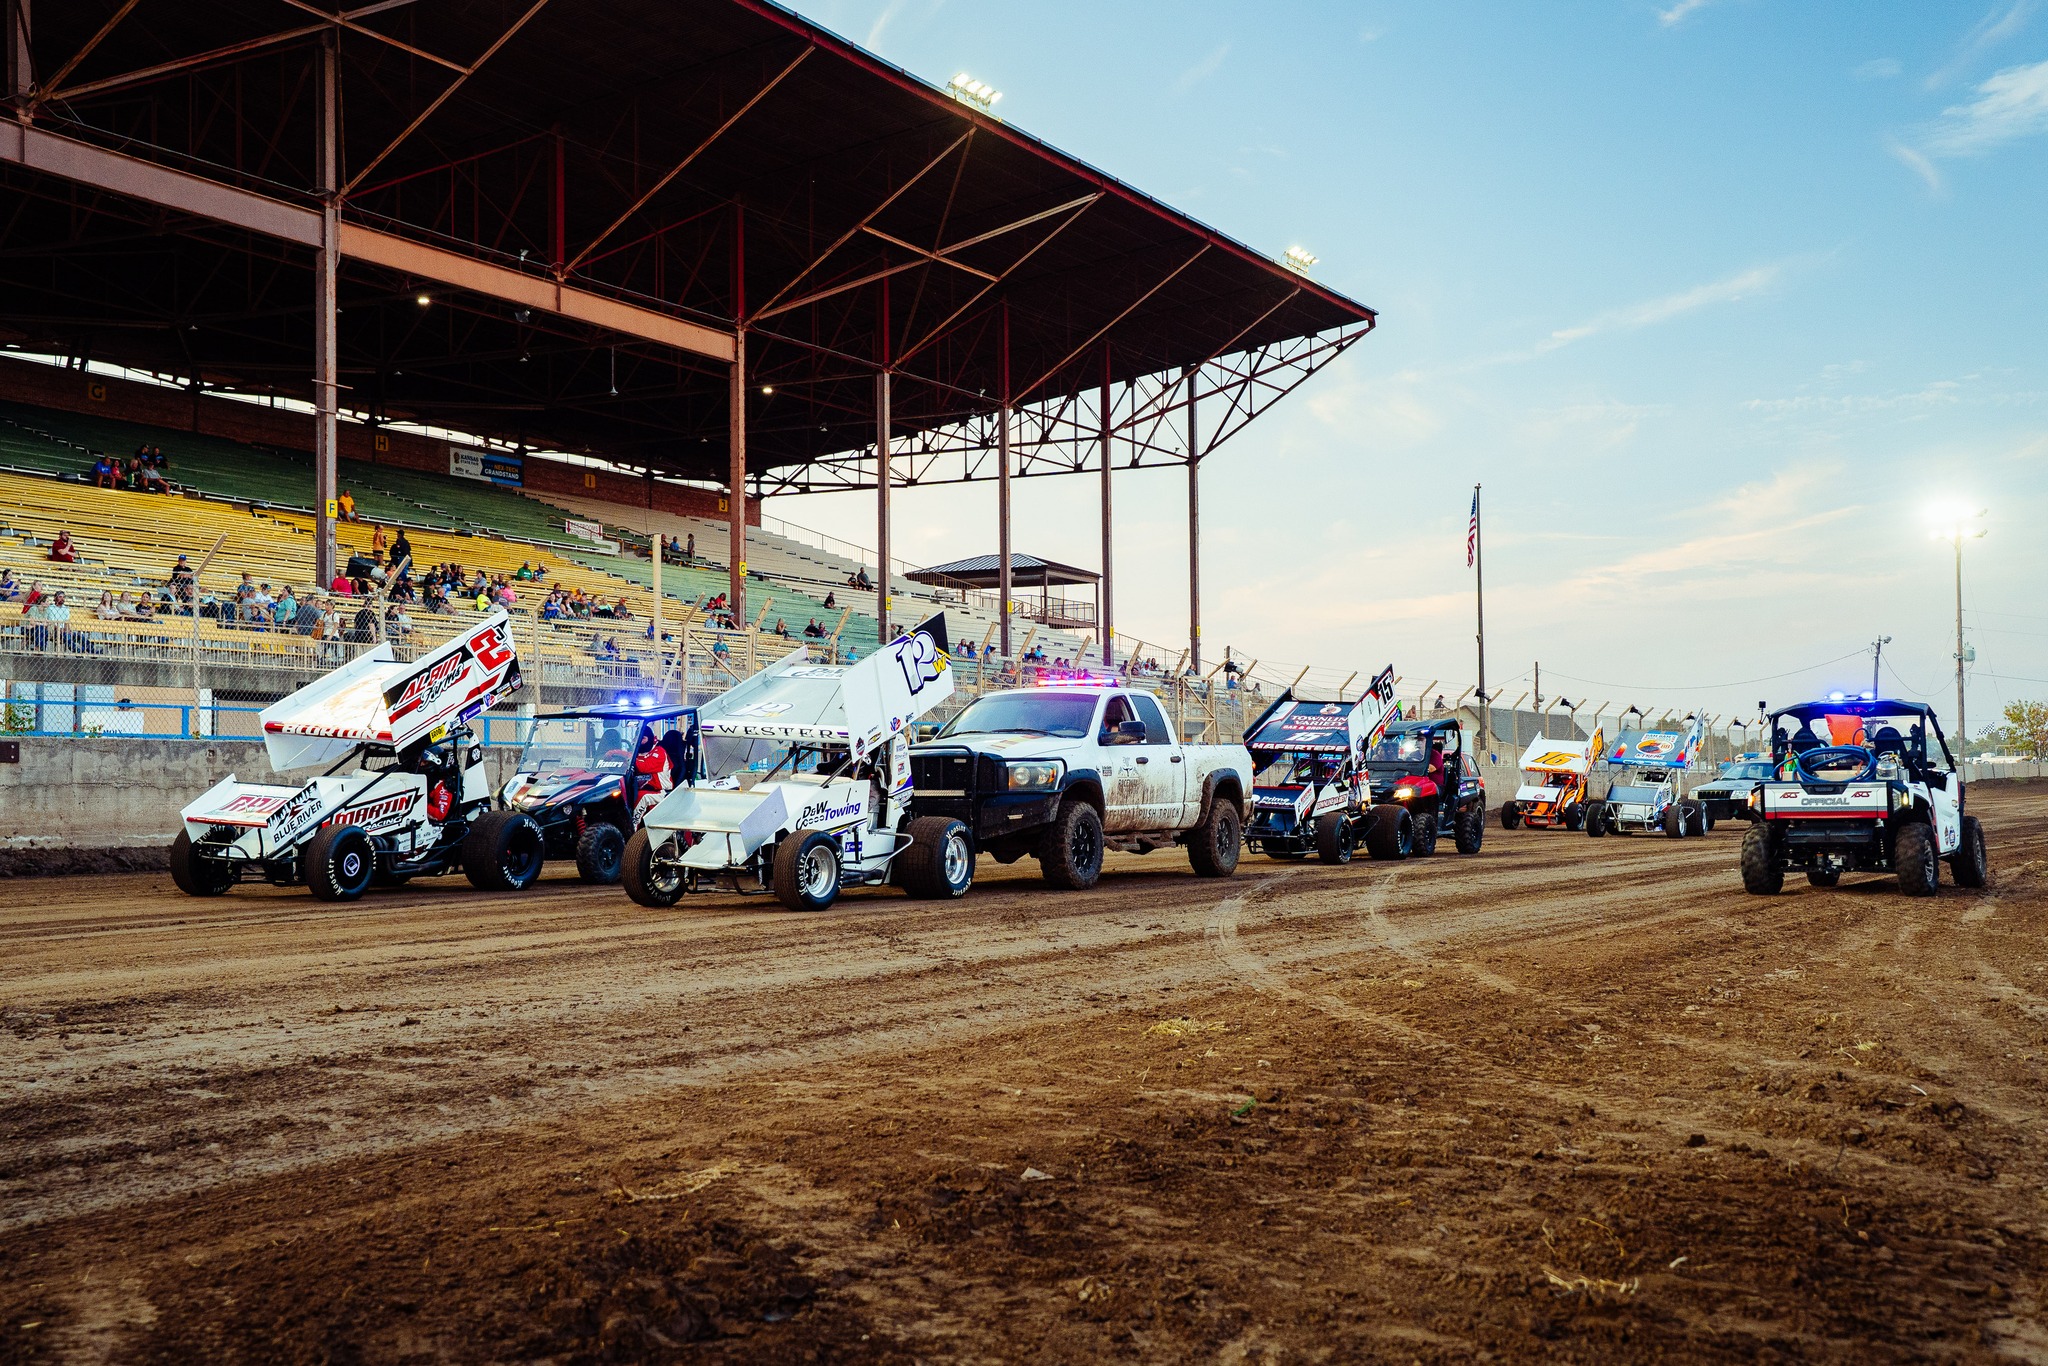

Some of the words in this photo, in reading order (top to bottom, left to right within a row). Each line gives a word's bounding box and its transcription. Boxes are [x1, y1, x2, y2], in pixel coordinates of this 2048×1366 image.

[91, 385, 102, 398] G
[377, 436, 387, 451] H
[484, 468, 519, 480] GRANDSTAND
[329, 502, 336, 514] F
[398, 653, 462, 703] ALBIN
[418, 663, 464, 711] Farms
[718, 724, 837, 739] WESTER
[1252, 742, 1348, 752] HAFERTEPE
[1531, 751, 1582, 766] 16
[1801, 797, 1850, 806] OFFICIAL
[334, 794, 412, 825] MARTIN
[802, 800, 828, 819] D&W
[825, 802, 861, 821] Towing
[1139, 808, 1156, 819] PUSH
[1159, 808, 1180, 819] TRUCK
[273, 820, 297, 843] BLUE
[297, 800, 322, 825] RIVER
[363, 814, 403, 831] RACING
[523, 818, 544, 842] Hoosier
[946, 825, 967, 839] Hoosier
[328, 858, 344, 896] Hoosier
[502, 866, 524, 889] Hoosier
